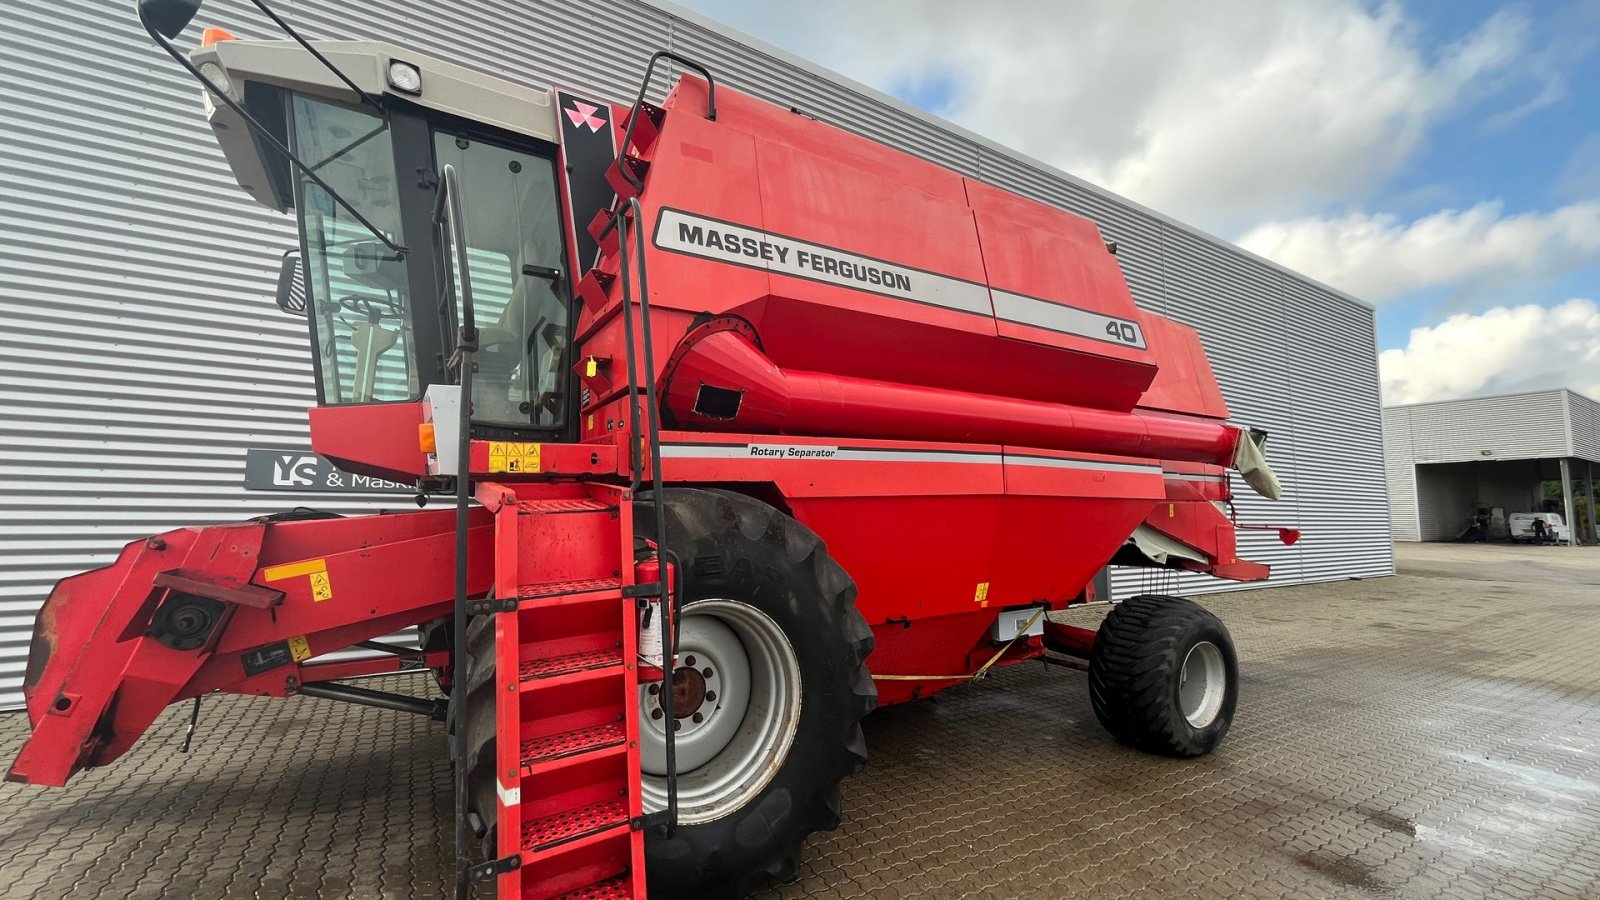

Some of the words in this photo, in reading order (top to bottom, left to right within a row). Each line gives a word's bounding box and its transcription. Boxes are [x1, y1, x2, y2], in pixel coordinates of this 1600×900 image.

[678, 222, 789, 264] MASSEY
[797, 250, 911, 292] FERGUSON
[1106, 321, 1136, 343] 40
[750, 446, 785, 458] Rotary
[788, 447, 835, 458] Separator
[326, 472, 345, 487] &
